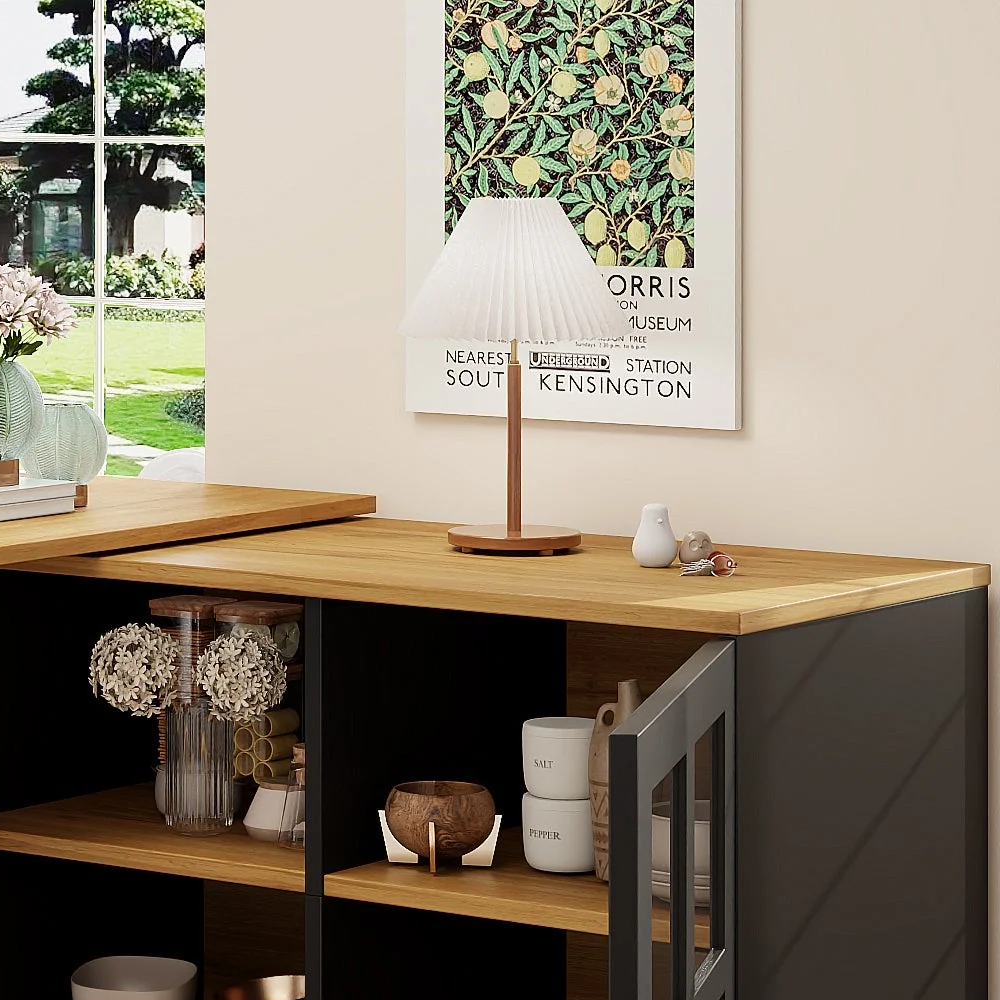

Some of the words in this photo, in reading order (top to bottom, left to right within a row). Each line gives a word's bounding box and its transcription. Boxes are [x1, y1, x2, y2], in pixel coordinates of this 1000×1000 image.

[602, 274, 691, 299] ORRIS
[616, 300, 638, 310] ON
[629, 335, 648, 344] FREE
[446, 350, 511, 364] NEAREST
[529, 352, 610, 370] UNDERGROUND
[626, 358, 692, 375] STATION
[446, 370, 505, 388] SOUT
[539, 374, 692, 399] KENSINGTON
[534, 759, 554, 769] SALT
[529, 828, 561, 841] PEPPER
